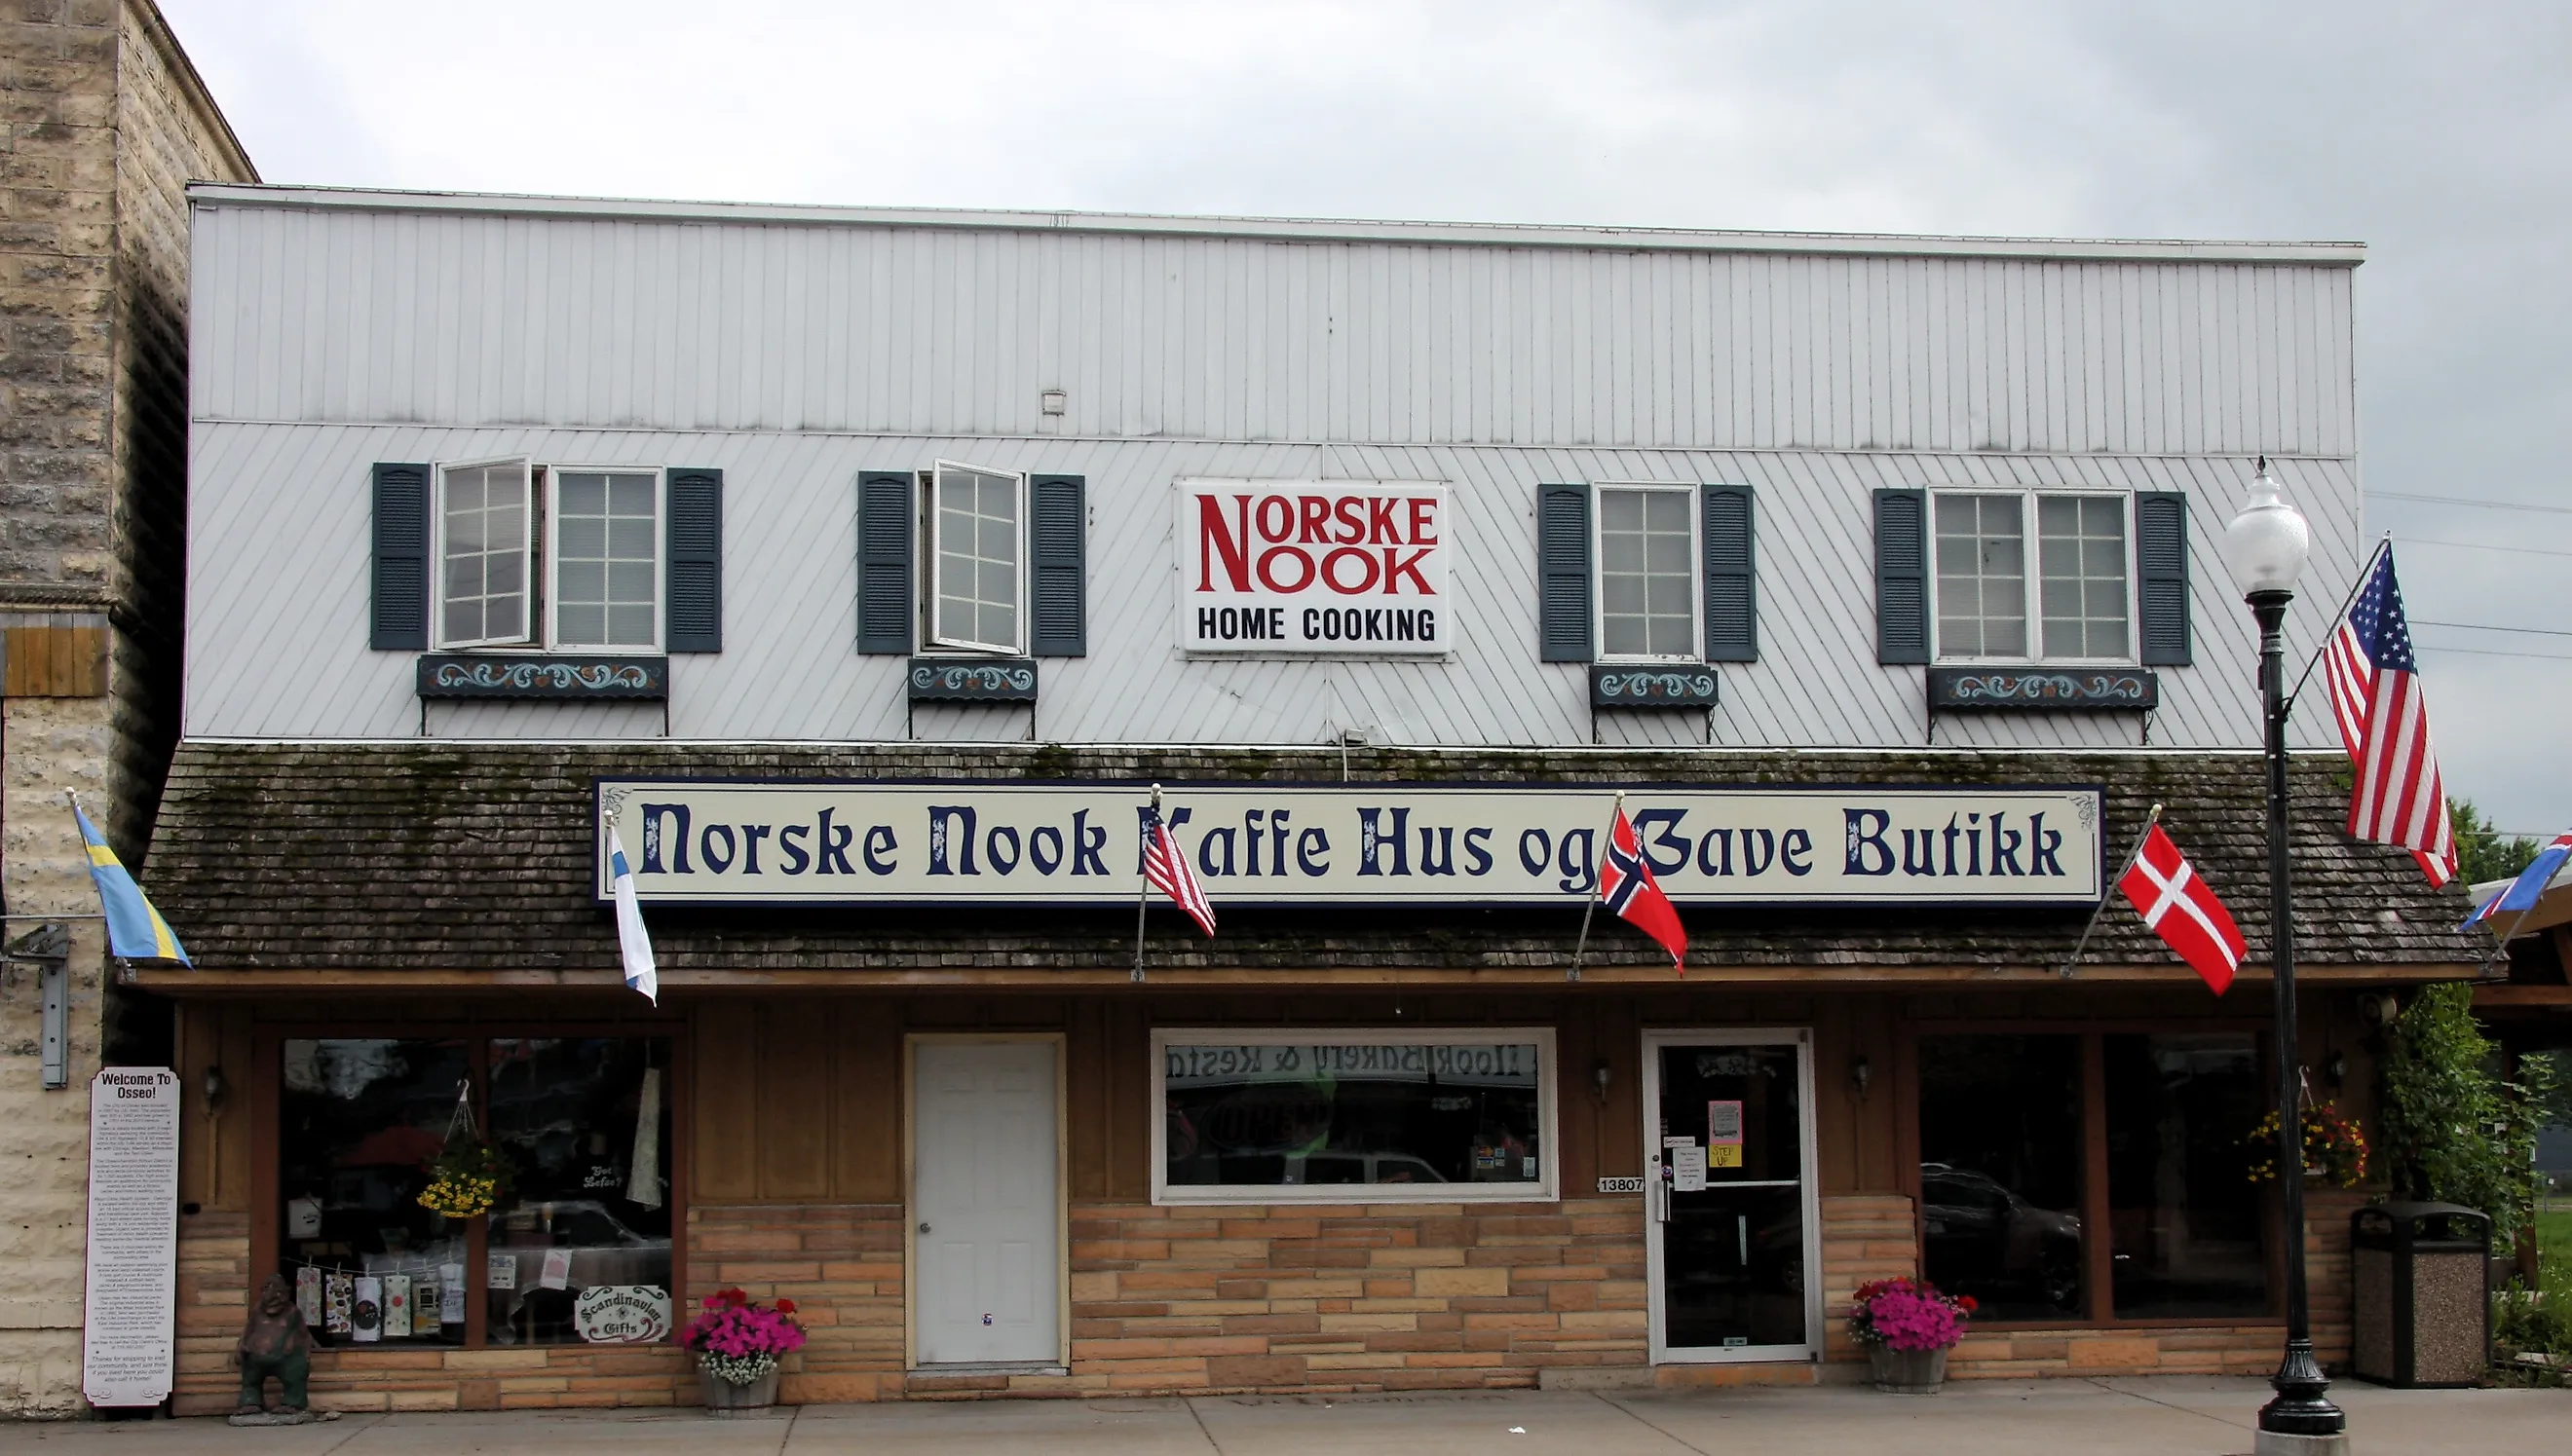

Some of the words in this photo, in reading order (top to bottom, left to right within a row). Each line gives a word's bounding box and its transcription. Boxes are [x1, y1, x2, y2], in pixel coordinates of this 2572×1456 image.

[1194, 495, 1438, 560] NORSKE
[1198, 607, 1285, 640] HOME
[1303, 608, 1435, 641] COOKING
[639, 803, 897, 876] Norske
[925, 804, 1111, 877] Nook
[1356, 806, 1494, 877] Hus
[1519, 828, 1596, 893] og
[1841, 807, 2066, 877] Butikk
[101, 1073, 154, 1085] Welcome
[157, 1073, 170, 1085] To
[118, 1087, 156, 1099] Osseo!
[1601, 1178, 1644, 1191] 13807
[581, 1292, 661, 1324] Scandinavian
[604, 1323, 637, 1334] Gifts
